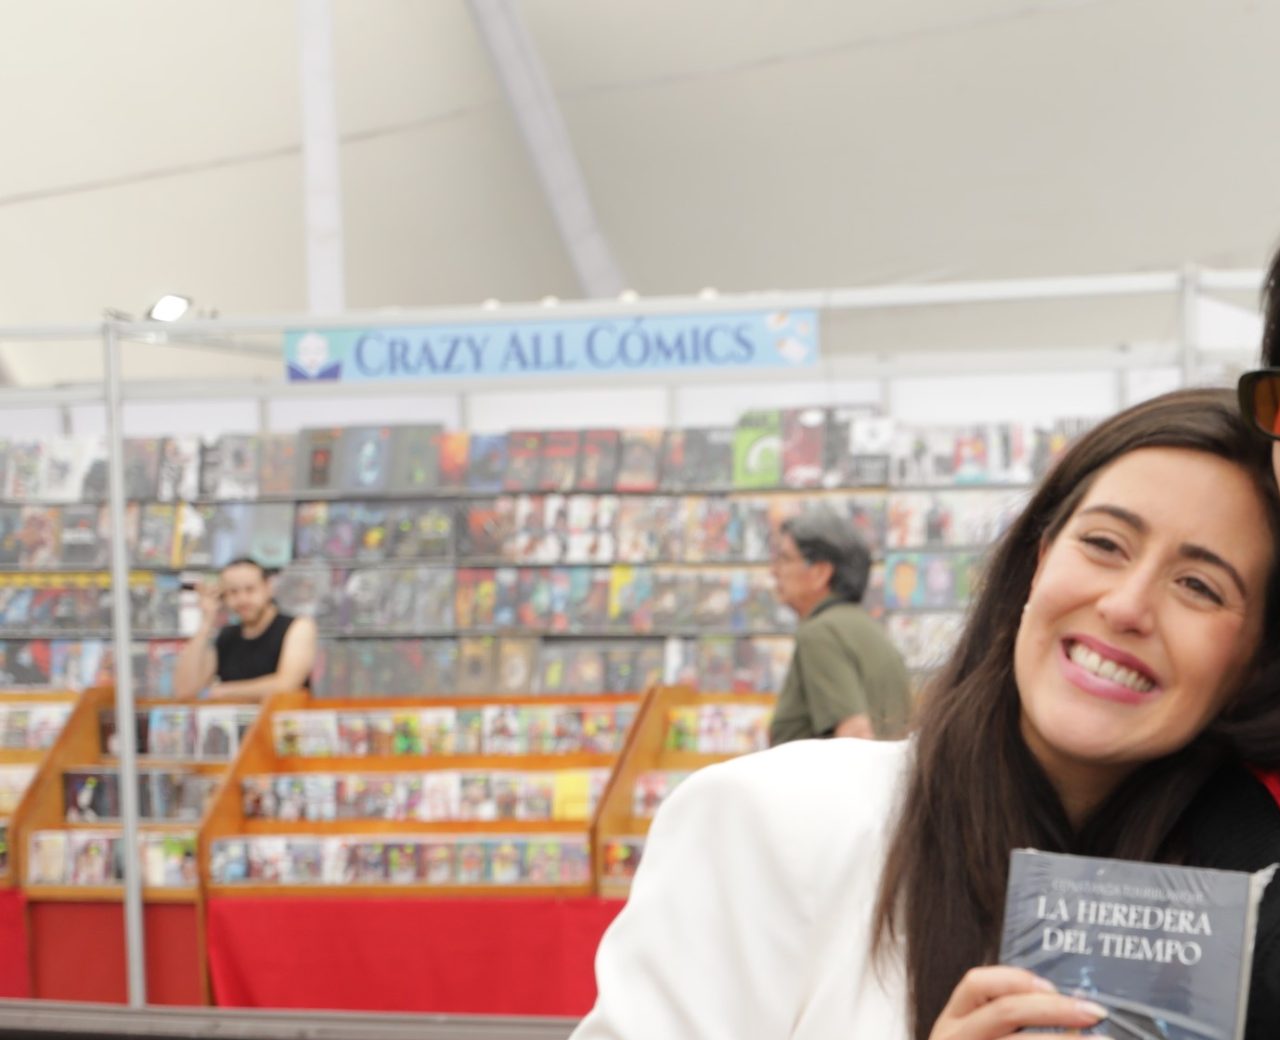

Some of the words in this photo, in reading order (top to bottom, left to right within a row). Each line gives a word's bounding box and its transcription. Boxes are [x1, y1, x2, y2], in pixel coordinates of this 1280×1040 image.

[354, 328, 492, 377] CRAZY
[501, 328, 577, 371] ALL
[584, 315, 756, 370] CÓMICS
[1037, 895, 1069, 922] LA
[1077, 899, 1213, 936] HEREDERA
[1042, 926, 1093, 955] DEL
[1098, 932, 1203, 966] TIEMPO
